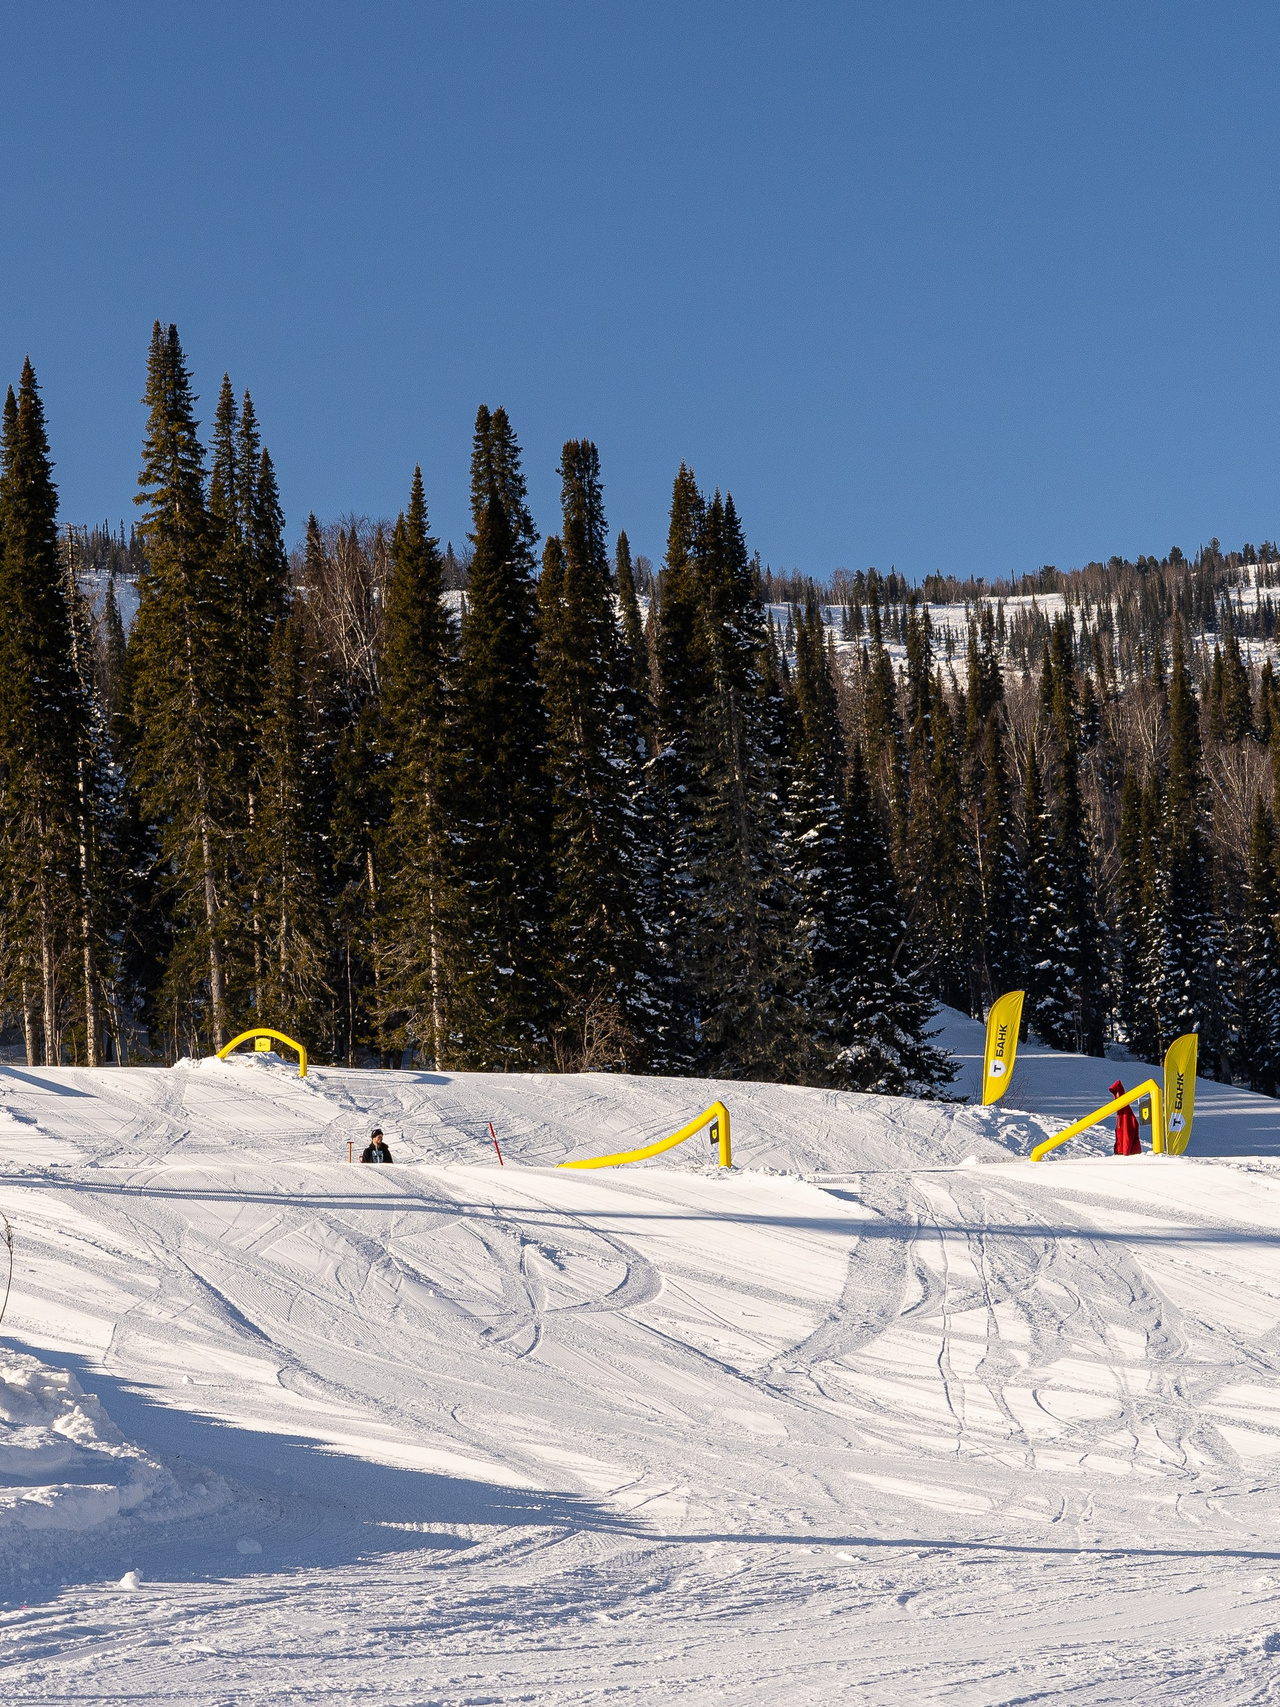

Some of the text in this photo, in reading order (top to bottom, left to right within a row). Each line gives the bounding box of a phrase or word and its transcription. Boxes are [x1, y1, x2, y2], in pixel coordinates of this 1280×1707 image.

[993, 1024, 1008, 1073] Т БАНК
[1172, 1071, 1185, 1127] Т БАНК
